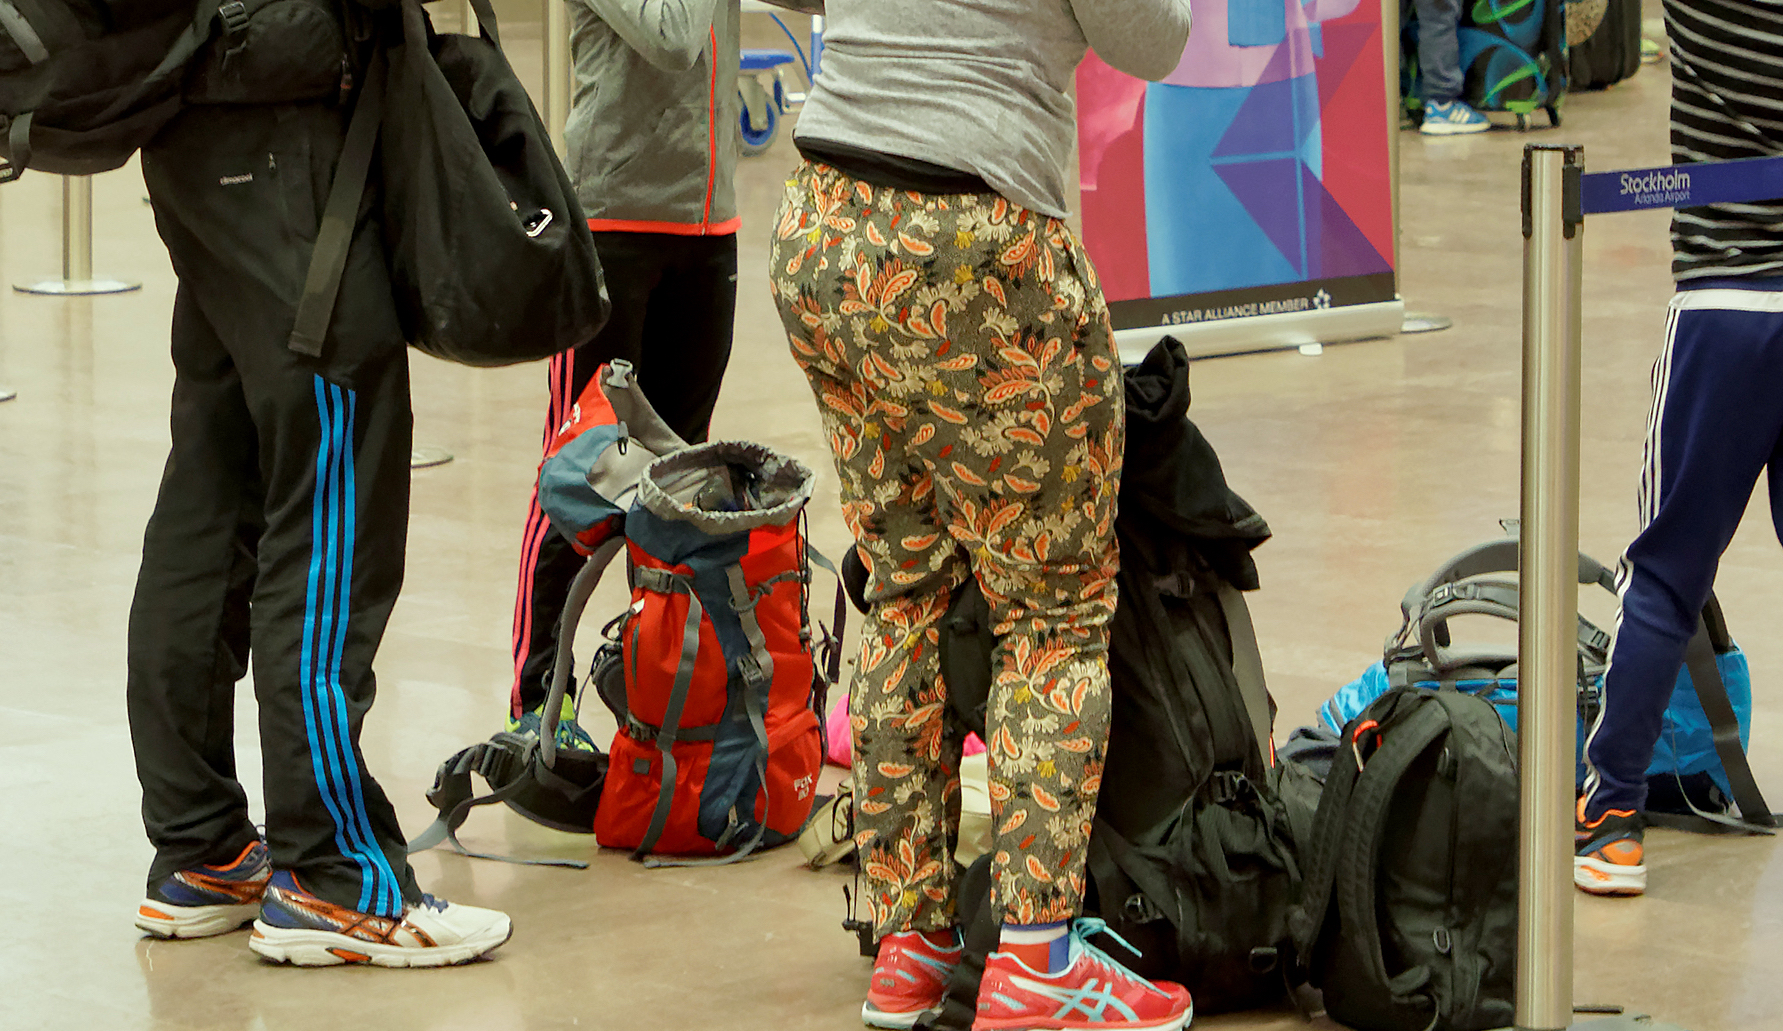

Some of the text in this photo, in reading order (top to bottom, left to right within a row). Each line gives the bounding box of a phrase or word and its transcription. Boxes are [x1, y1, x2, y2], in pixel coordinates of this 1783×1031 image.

[1620, 169, 1691, 195] Stockholm
[1161, 297, 1309, 326] A STAR ALLIANCE MEMBER
